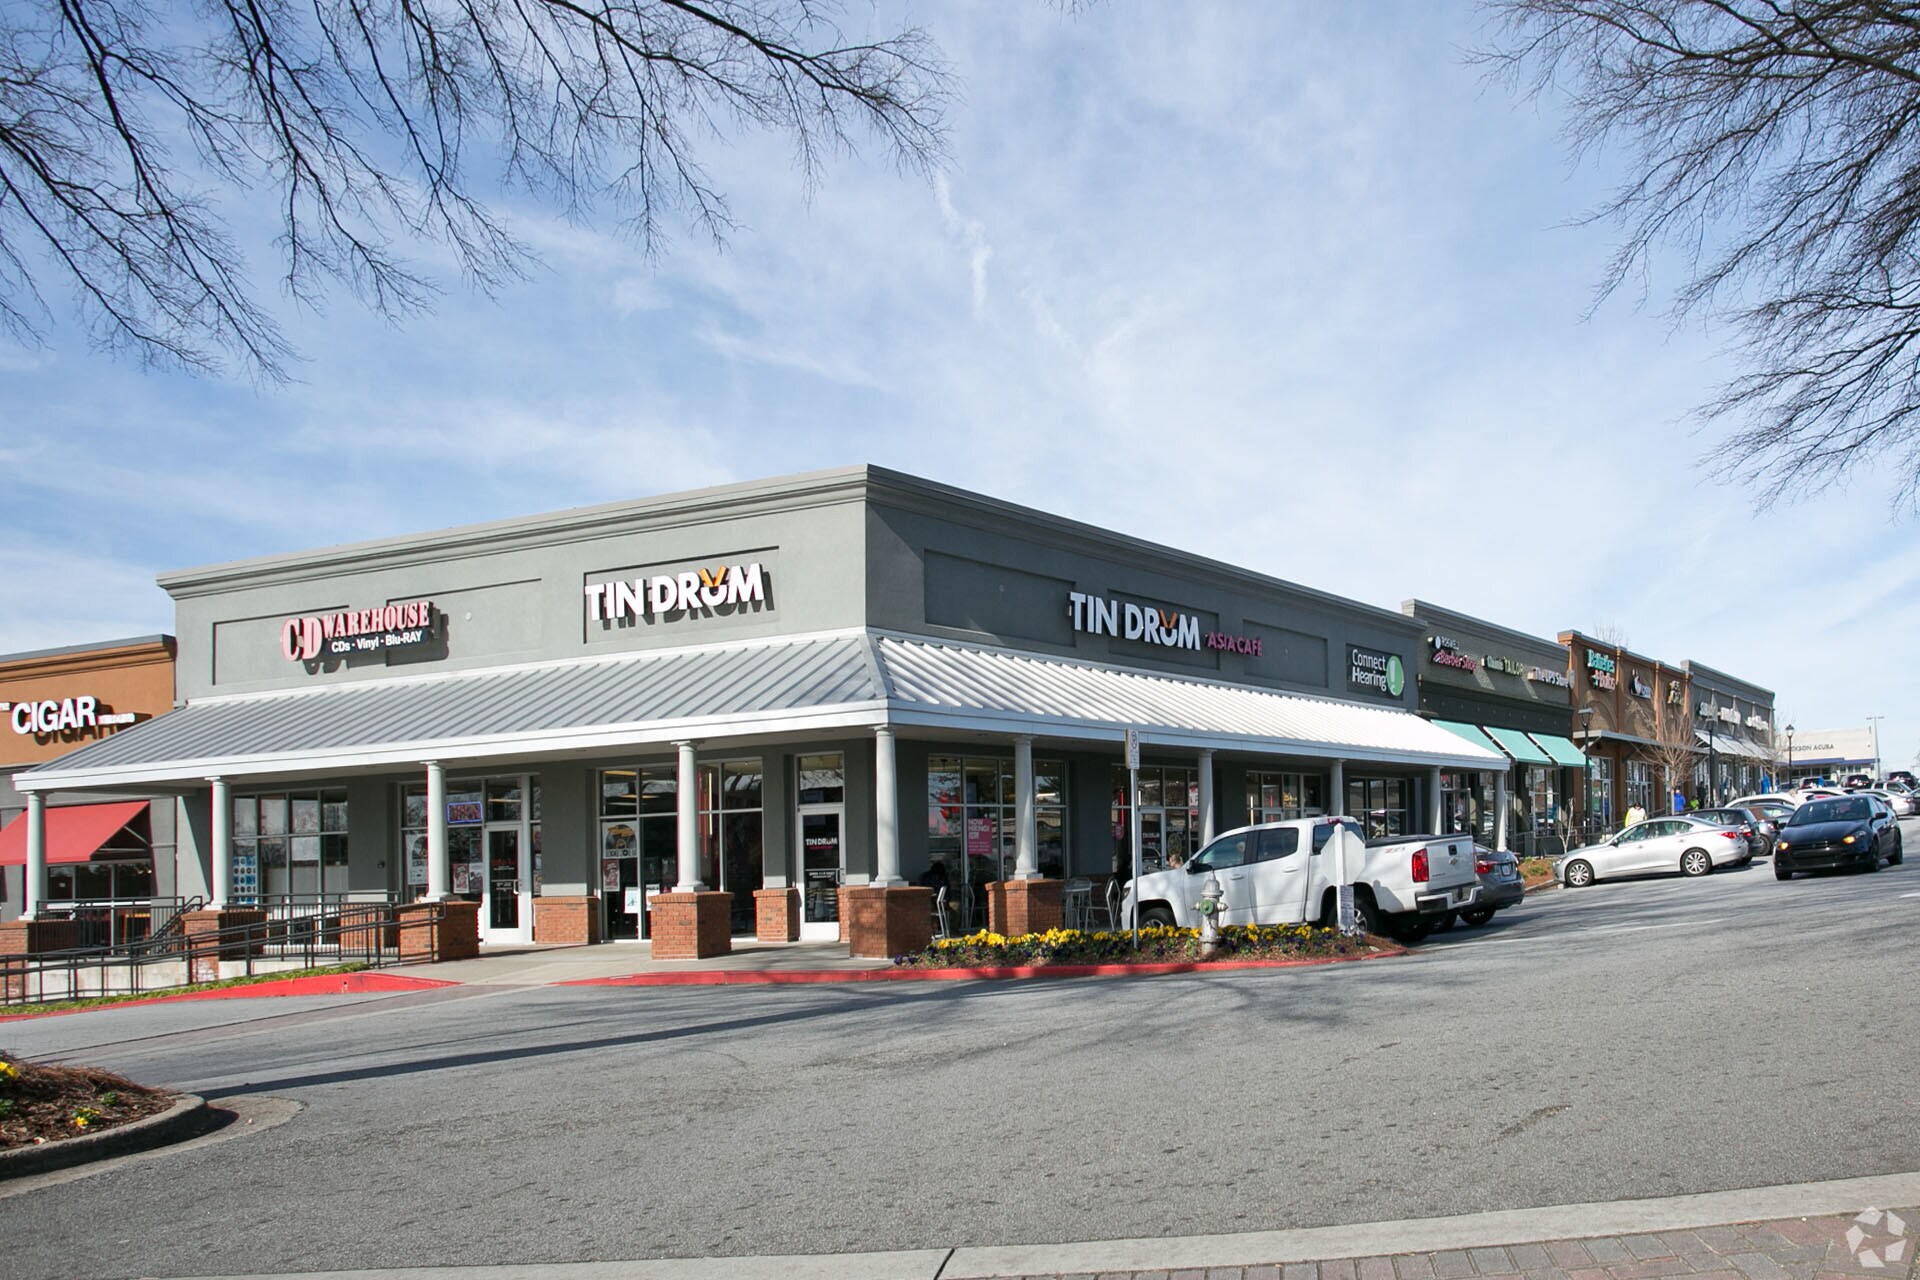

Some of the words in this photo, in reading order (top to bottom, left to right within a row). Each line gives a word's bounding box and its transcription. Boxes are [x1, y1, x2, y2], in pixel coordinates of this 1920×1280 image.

[585, 579, 644, 621] TIN
[652, 563, 765, 613] DRUM
[280, 616, 323, 662] CD
[322, 601, 430, 639] WAREHOUSE
[1070, 591, 1118, 637] TIN
[1125, 603, 1201, 650] DRUM
[331, 641, 351, 652] CDs
[356, 637, 380, 650] Vinyl
[385, 630, 423, 646] Blu-RAY
[1207, 631, 1237, 652] ASIA
[1352, 649, 1386, 671] Connect
[1351, 666, 1387, 691] Hearing
[12, 695, 97, 735] CIGAR
[805, 838, 817, 846] TIN
